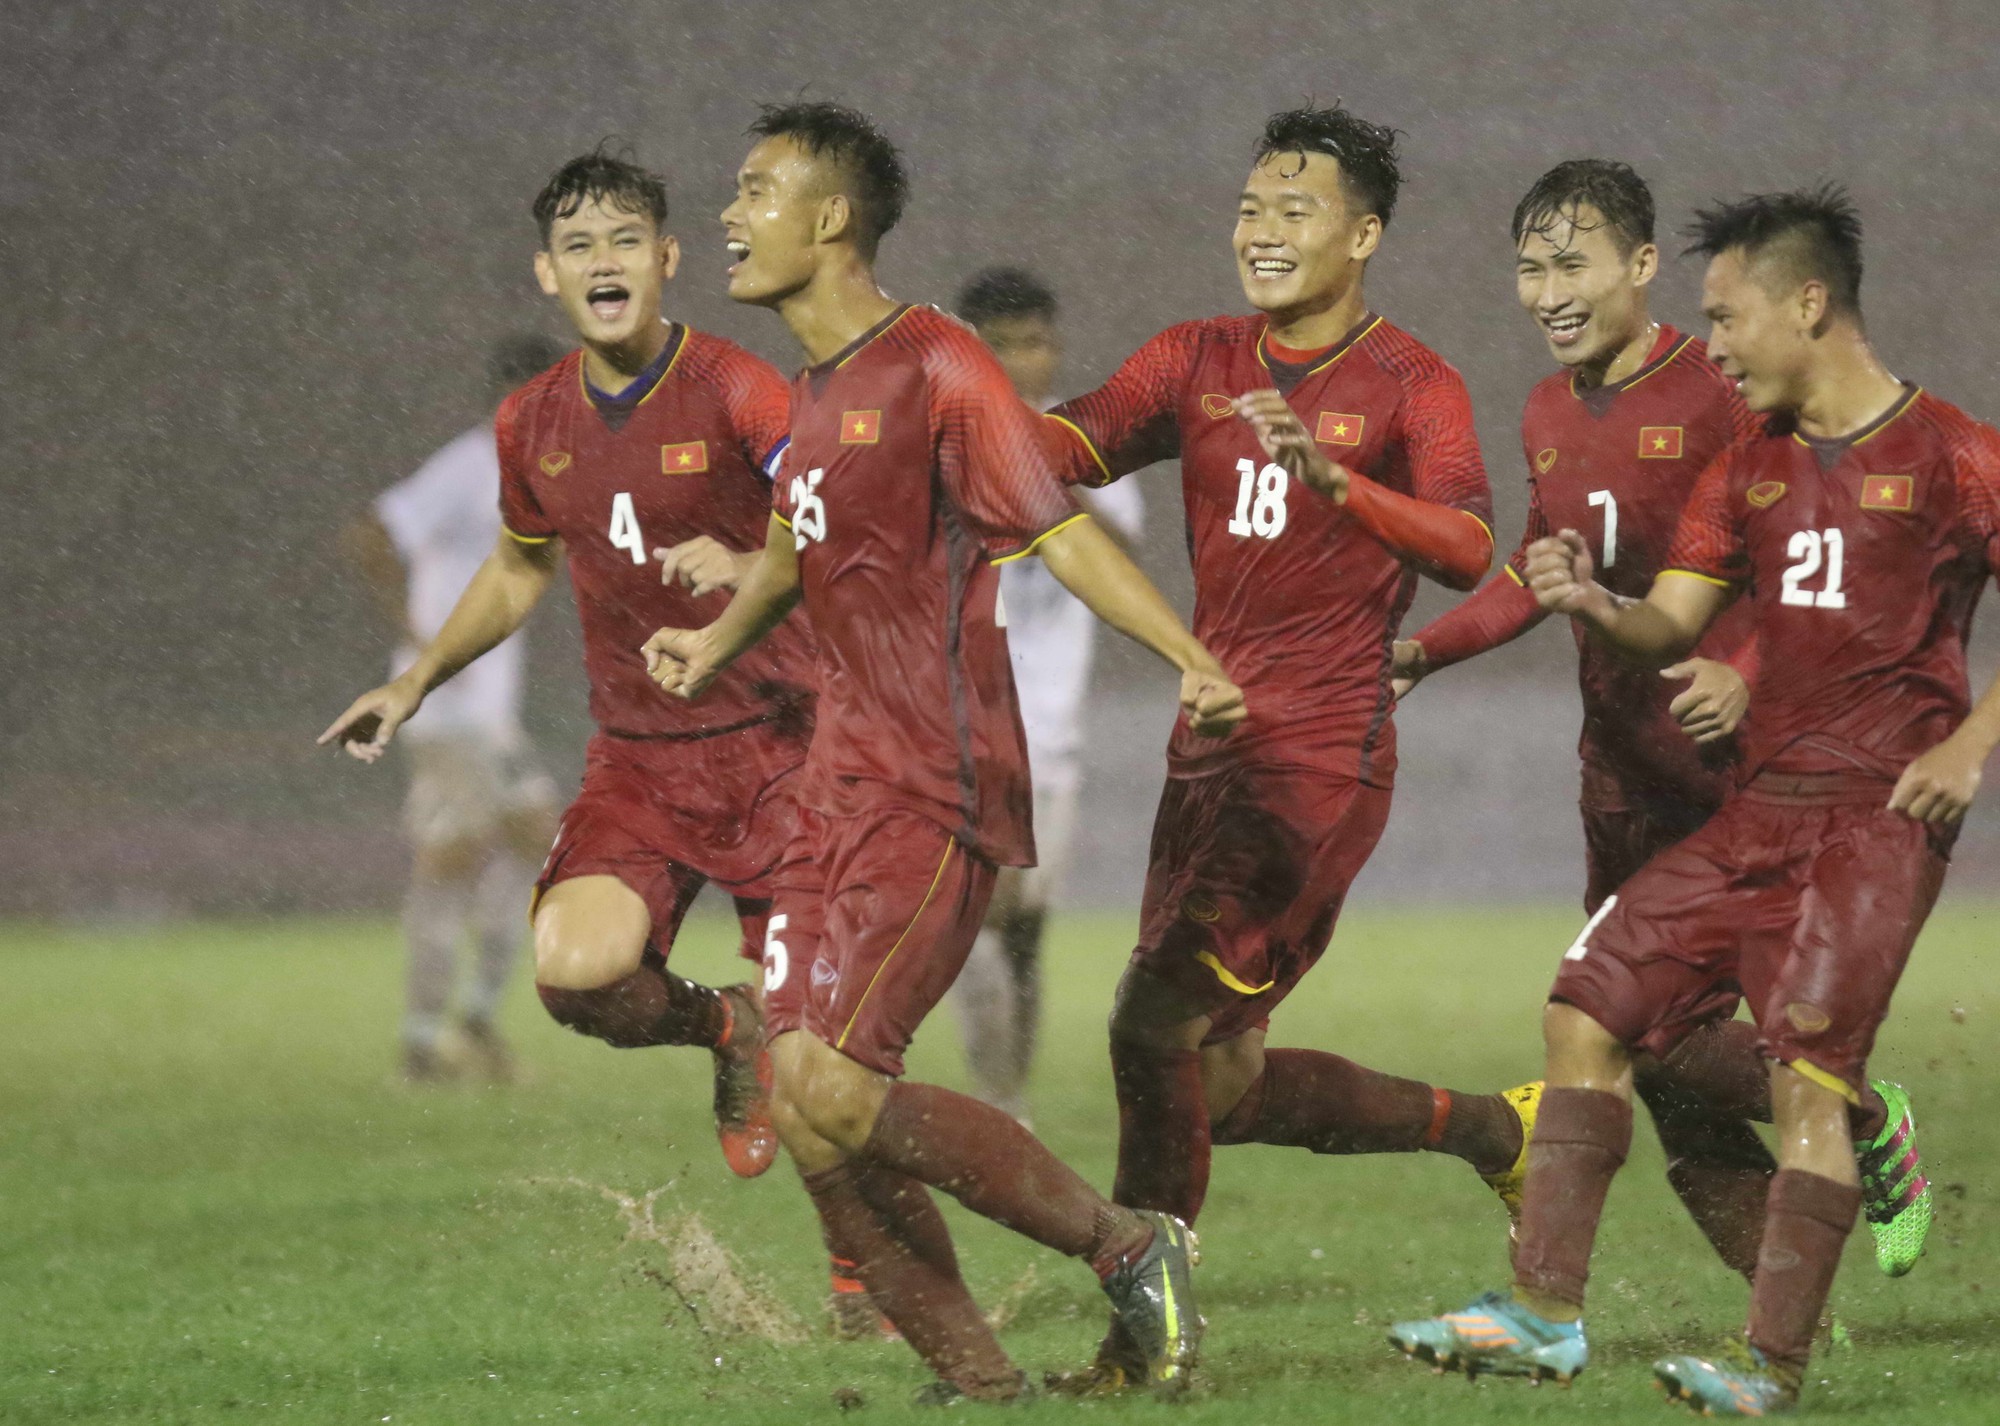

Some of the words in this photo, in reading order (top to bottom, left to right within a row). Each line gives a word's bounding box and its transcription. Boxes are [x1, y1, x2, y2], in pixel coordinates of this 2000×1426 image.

[608, 492, 647, 565] 4
[790, 467, 826, 551] 25
[1228, 458, 1288, 539] 18
[1587, 489, 1617, 568] 7
[1780, 527, 1847, 609] 21
[763, 913, 789, 992] 5
